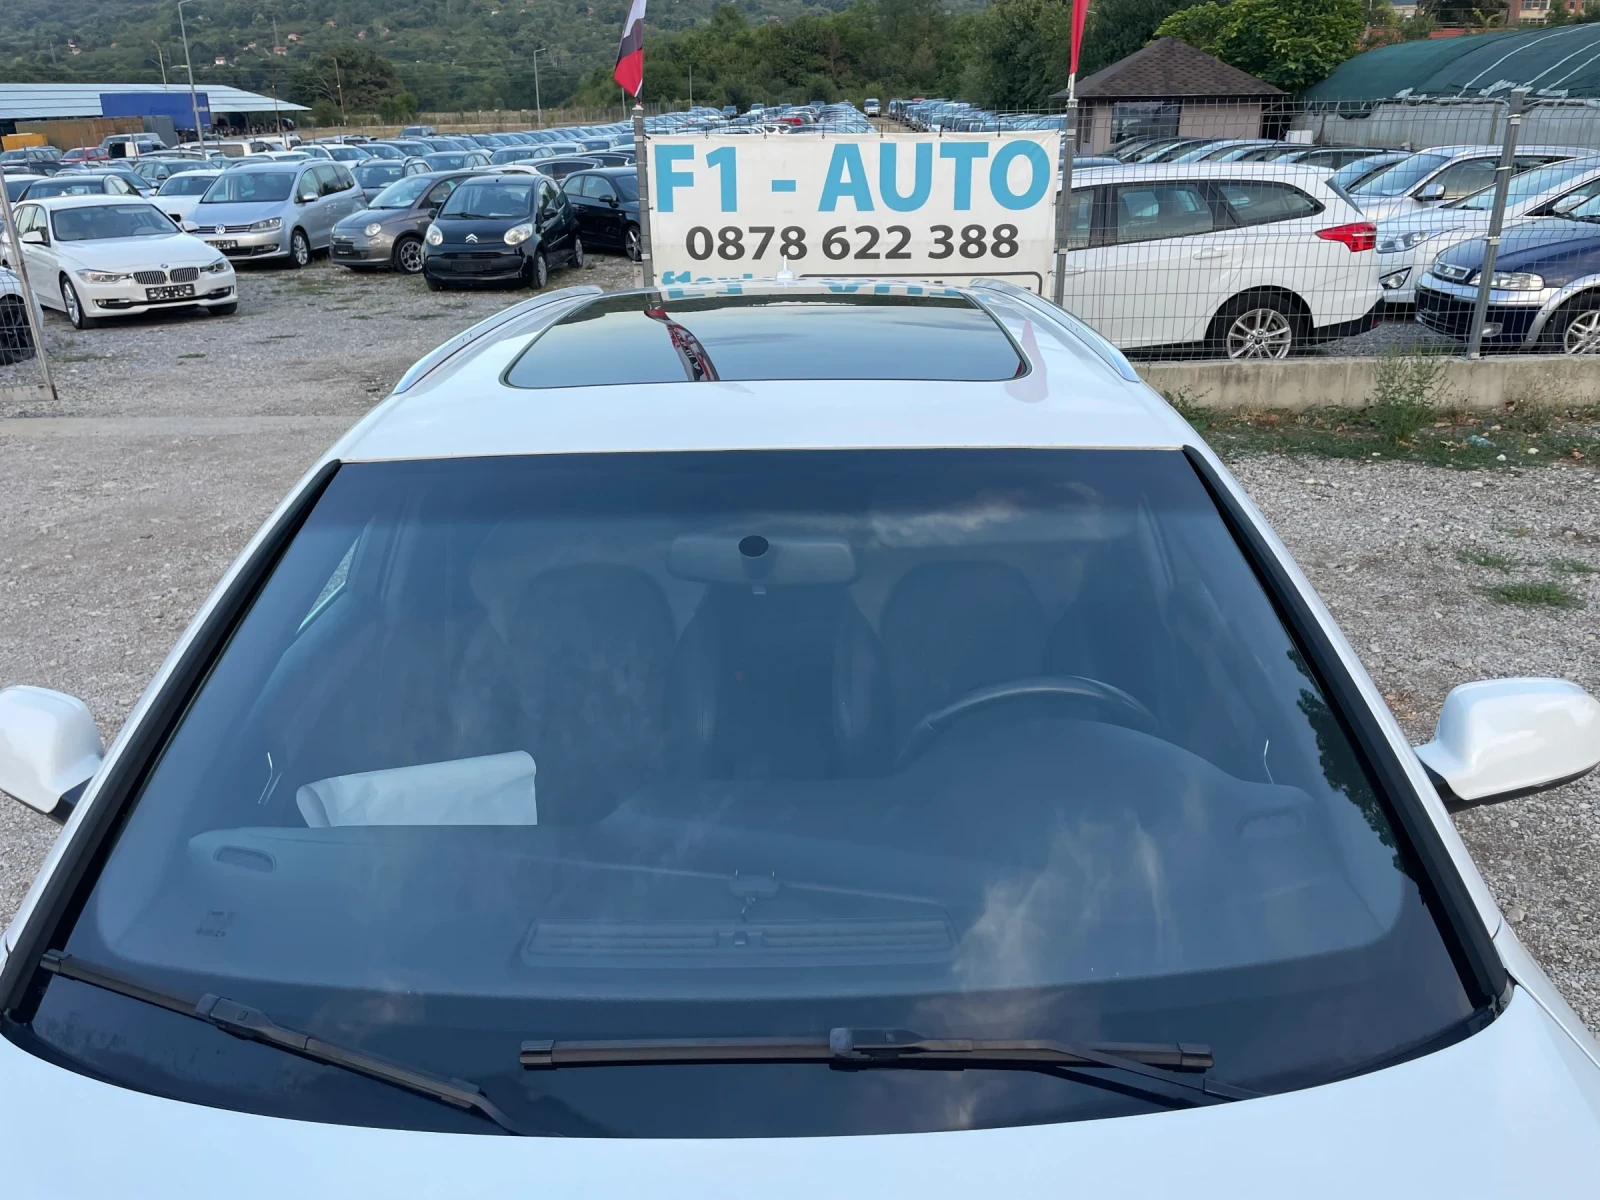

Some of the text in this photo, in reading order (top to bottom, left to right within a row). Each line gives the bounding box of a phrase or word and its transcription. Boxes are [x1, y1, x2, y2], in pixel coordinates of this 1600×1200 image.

[655, 139, 1051, 213] F1 - AUTO
[685, 223, 1019, 261] 0878 622 388
